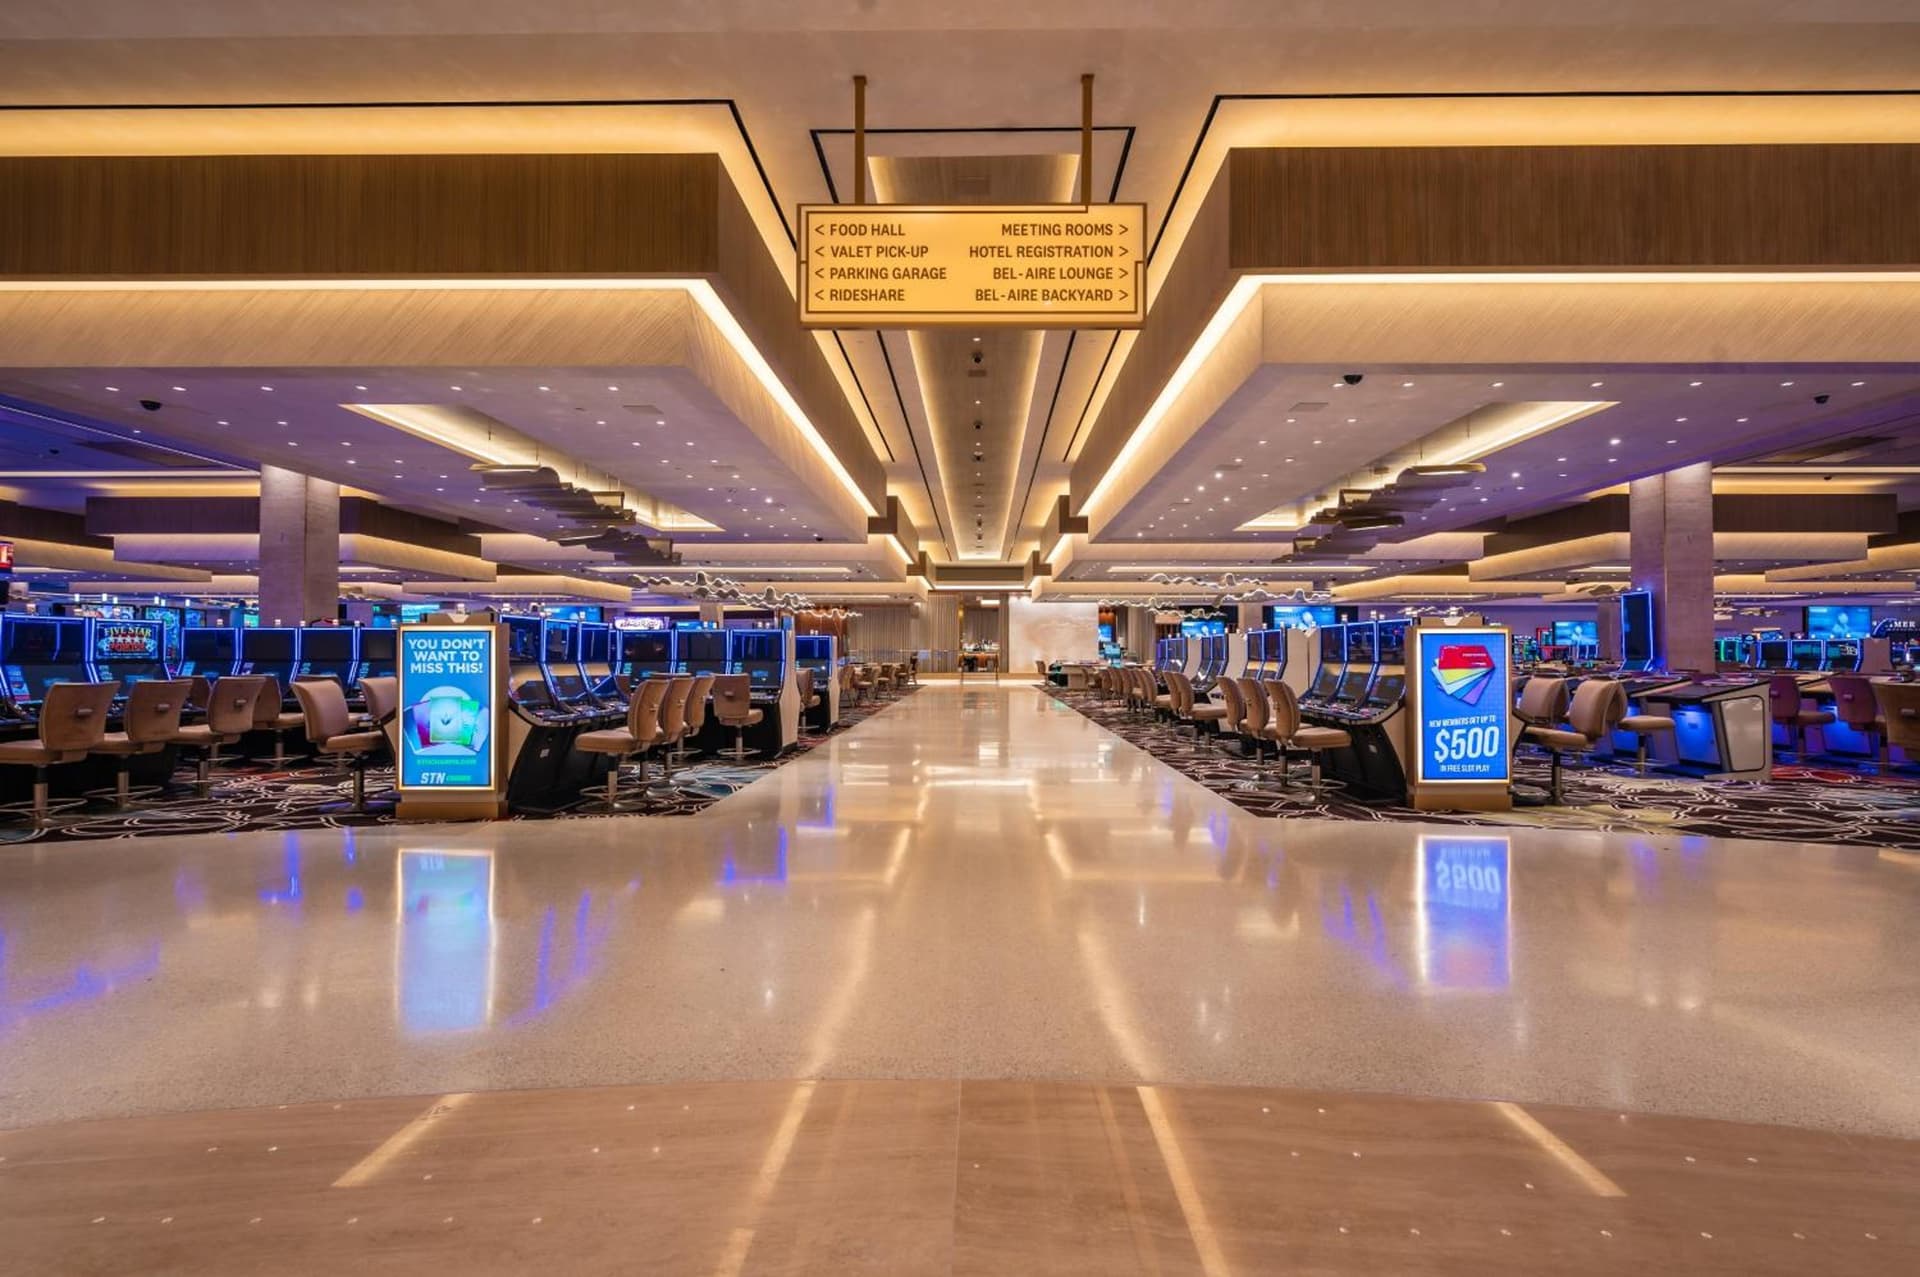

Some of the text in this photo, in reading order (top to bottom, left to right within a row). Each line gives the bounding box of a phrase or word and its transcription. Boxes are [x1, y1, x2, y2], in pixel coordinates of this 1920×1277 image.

[829, 223, 906, 237] FOOD HALL
[1001, 223, 1114, 237] MEETING ROOMS
[830, 245, 929, 258] VALET PICK-UP
[969, 245, 1114, 258] HOTEL REGISTRATION
[829, 267, 947, 280] PARKING GARAGE
[992, 266, 1114, 280] BEL-AIRE LOUNGE
[829, 288, 905, 302] RIDESHARE
[975, 288, 1114, 302] BEL-AIRE BACKYARD
[408, 639, 486, 650] YOU DON'T
[413, 651, 480, 662] WANT TO
[410, 663, 484, 674] MISS THIS!
[1433, 726, 1500, 763] $500
[420, 772, 446, 784] STN
